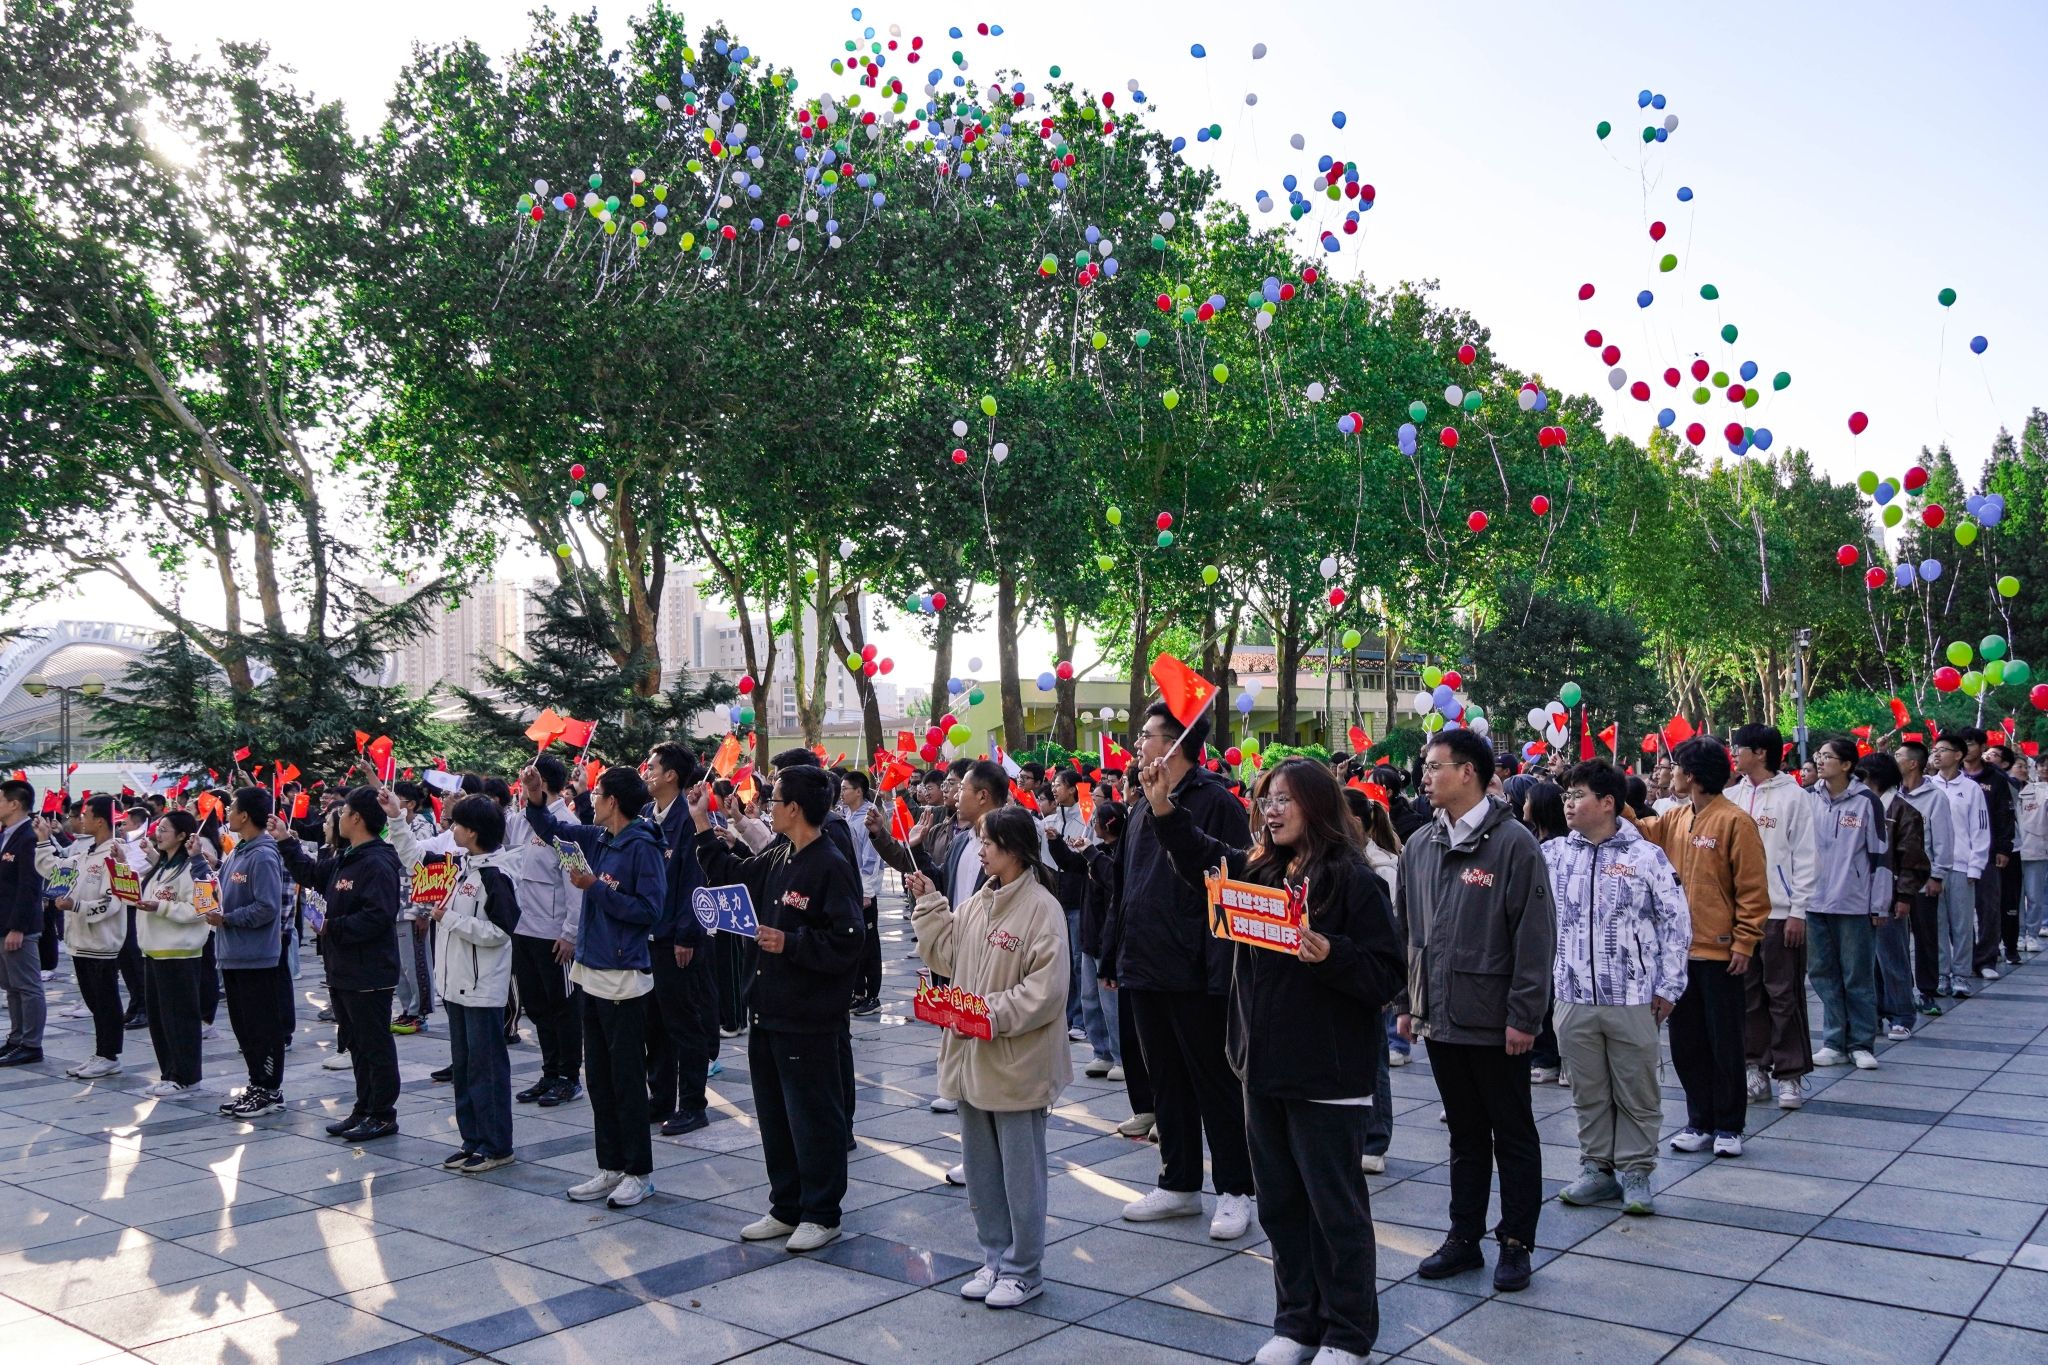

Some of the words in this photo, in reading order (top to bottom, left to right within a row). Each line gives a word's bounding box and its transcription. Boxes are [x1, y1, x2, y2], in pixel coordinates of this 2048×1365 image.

[718, 891, 741, 911] 魅力
[1222, 887, 1286, 918] 盛世华诞
[730, 910, 755, 930] 大工
[1232, 915, 1299, 947] 欢度国庆
[917, 978, 990, 1018] 大工与国同龄
